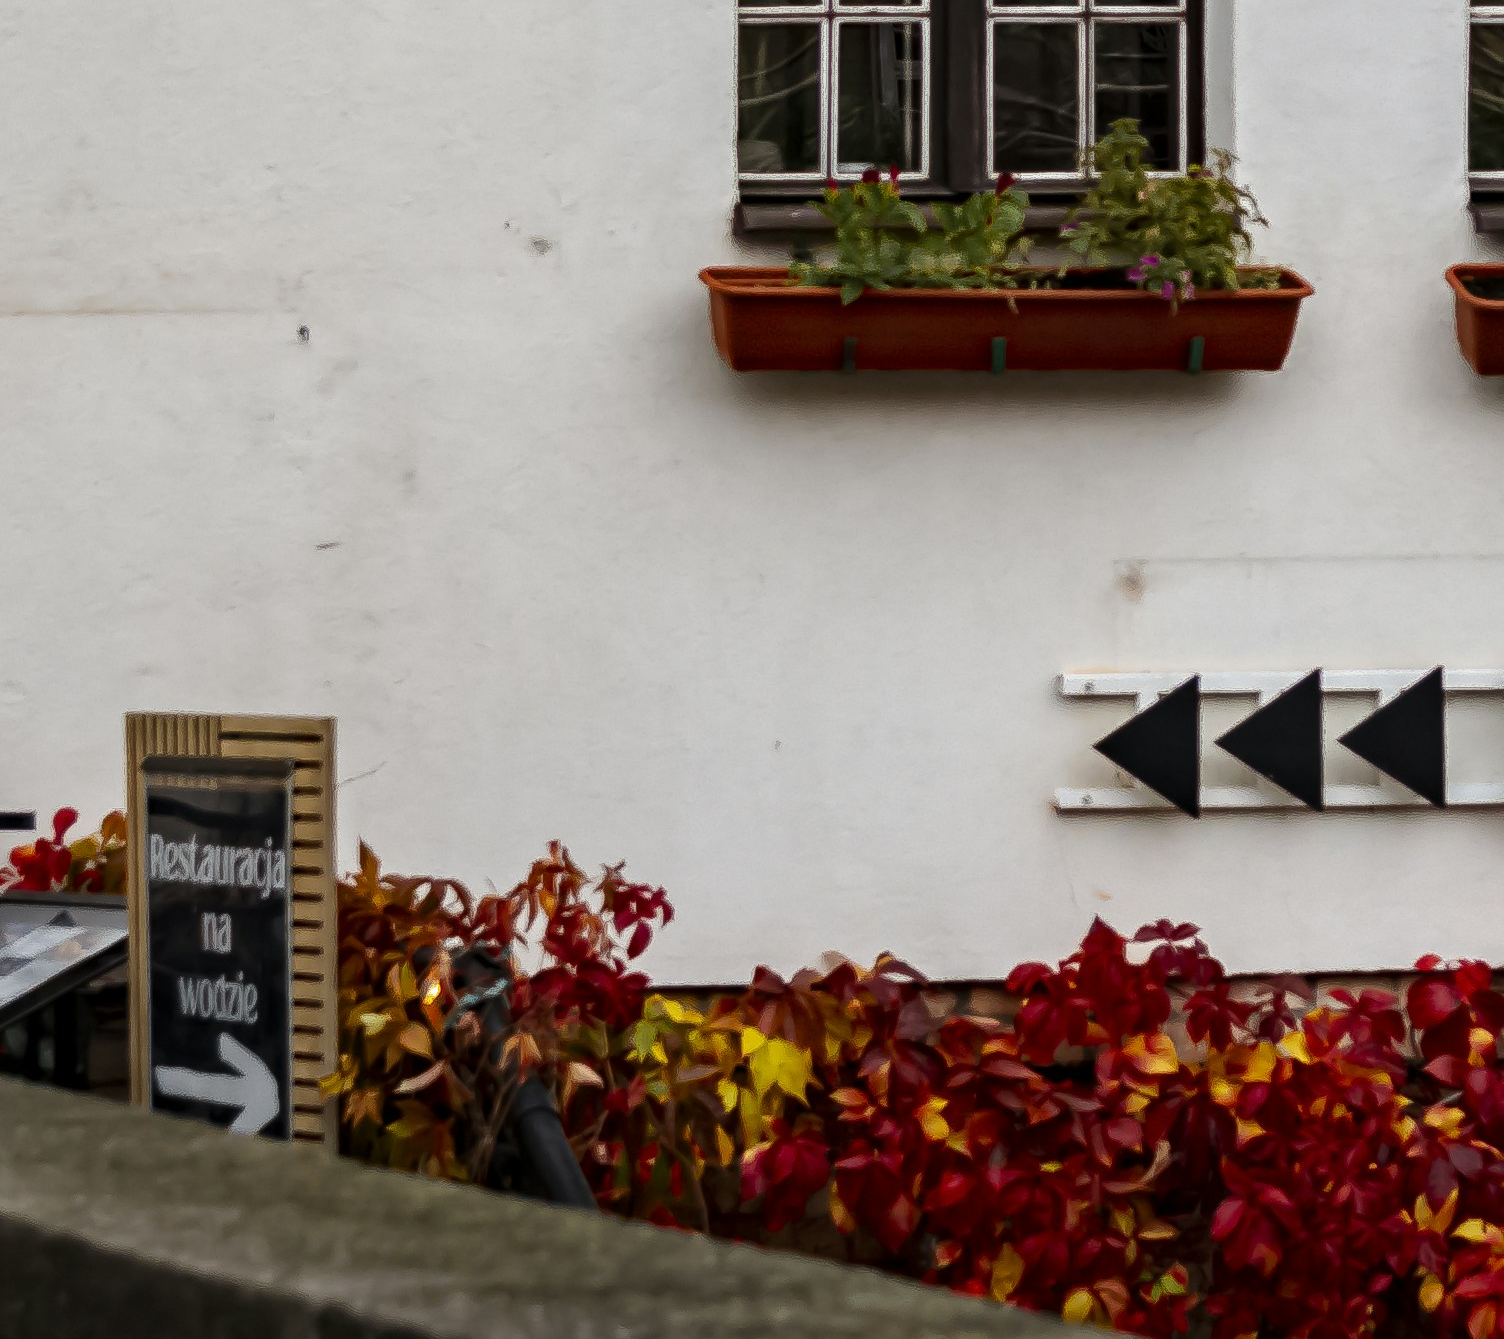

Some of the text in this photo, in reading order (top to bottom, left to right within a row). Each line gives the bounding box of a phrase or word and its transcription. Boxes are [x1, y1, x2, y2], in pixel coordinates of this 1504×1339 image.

[149, 834, 285, 899] Restauracja
[202, 912, 231, 954] na
[178, 971, 258, 1024] wodzie
